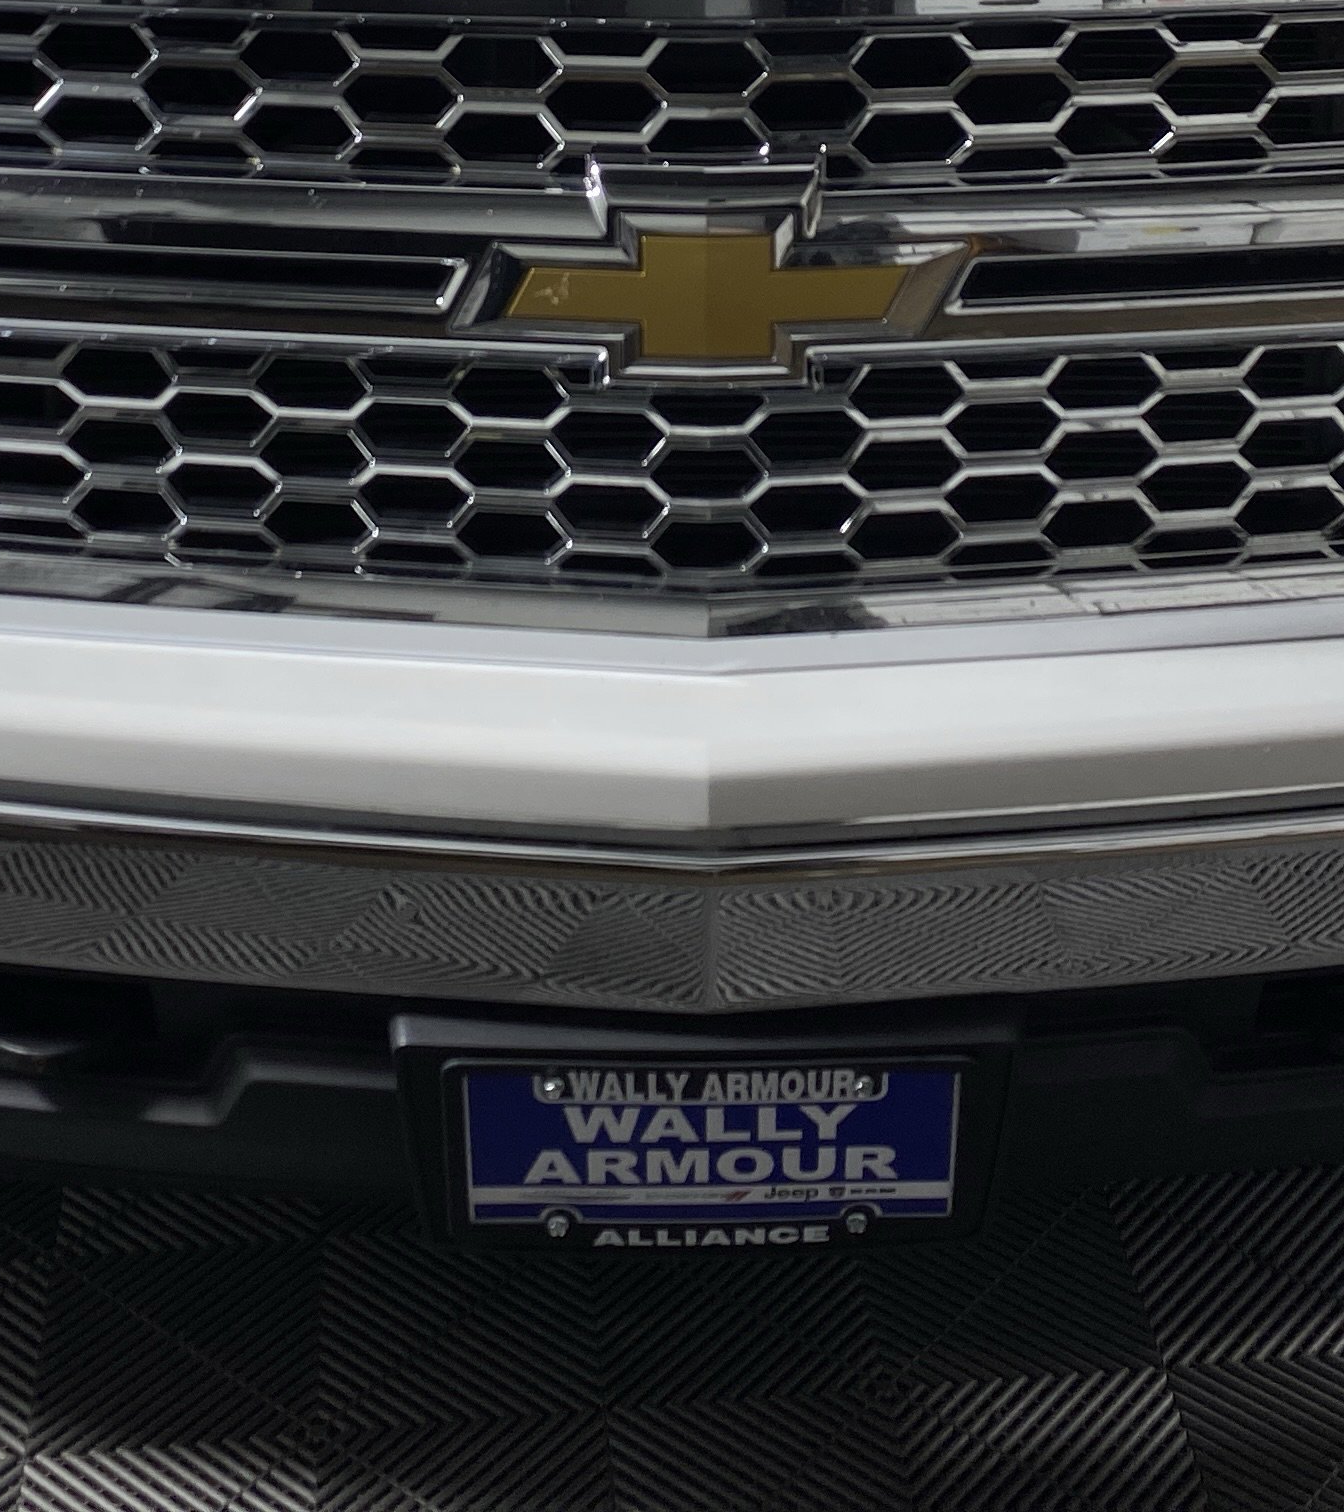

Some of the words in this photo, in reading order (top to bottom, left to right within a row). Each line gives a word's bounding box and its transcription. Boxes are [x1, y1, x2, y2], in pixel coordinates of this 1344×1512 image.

[568, 1072, 690, 1102] WALLY
[701, 1070, 857, 1102] ARMOUR
[564, 1105, 856, 1144] WALLY
[524, 1146, 899, 1185] ARMOUR
[764, 1186, 820, 1202] Jeep
[593, 1224, 831, 1248] ALLIANCE
